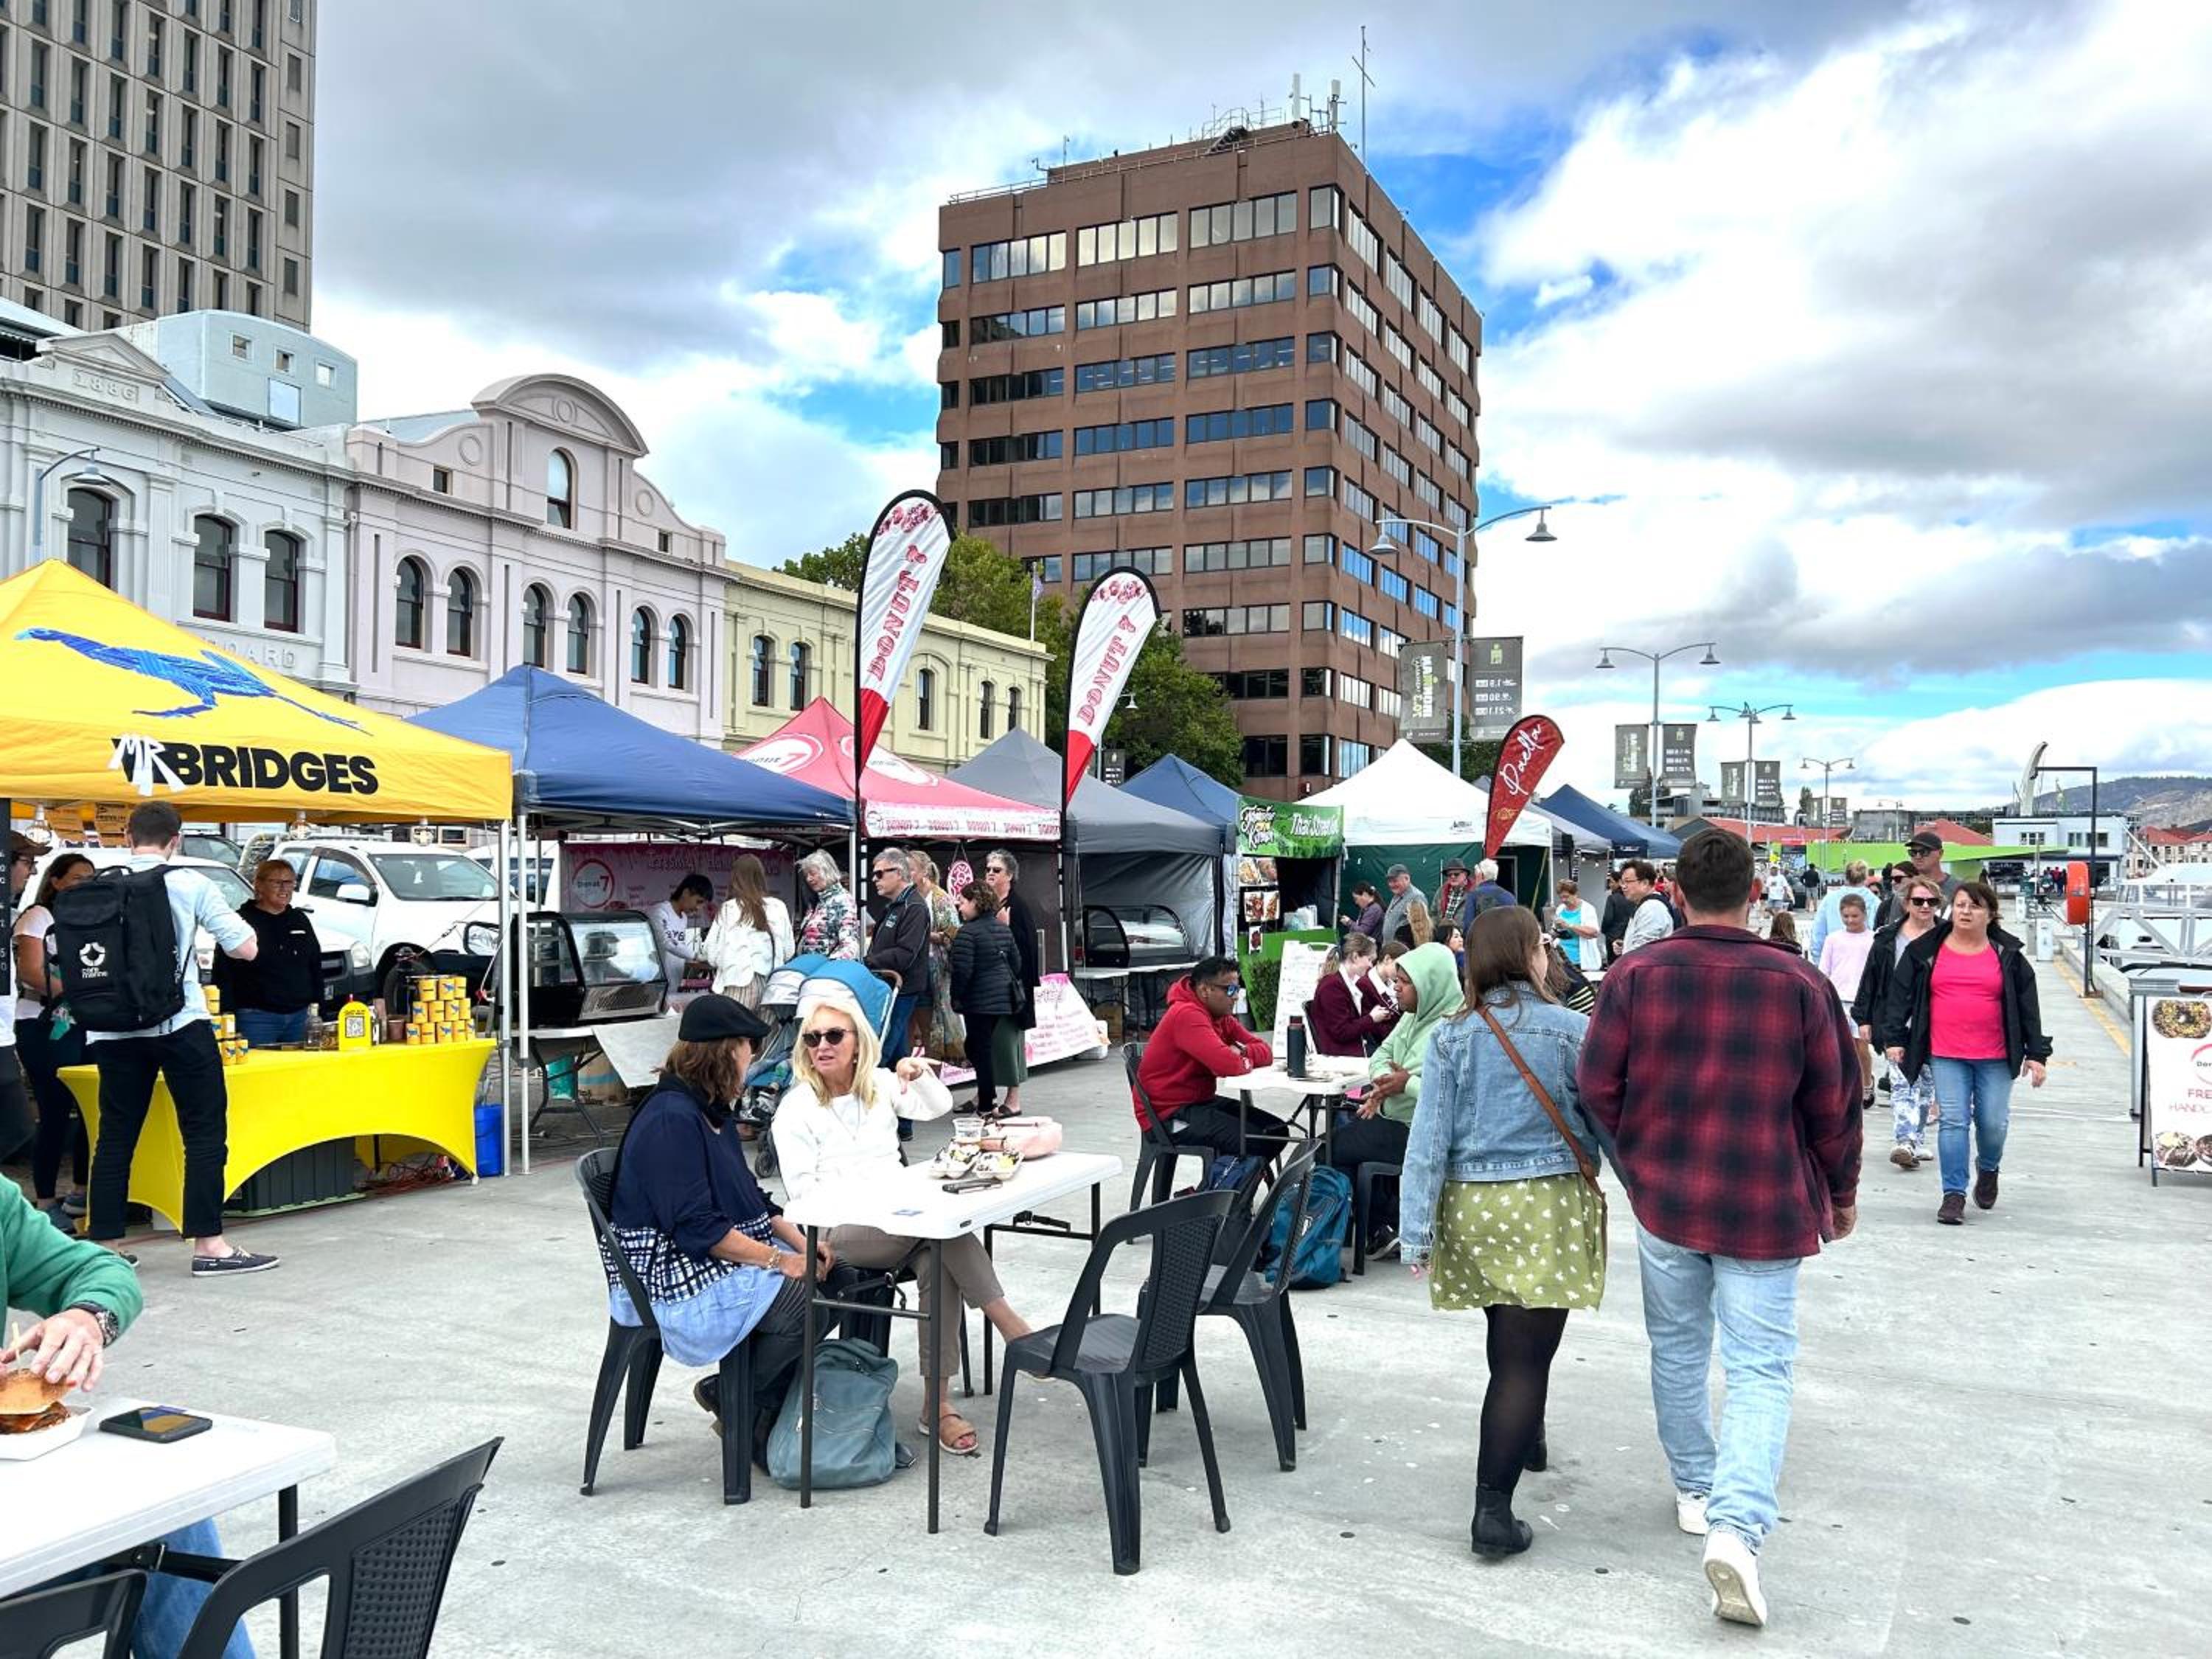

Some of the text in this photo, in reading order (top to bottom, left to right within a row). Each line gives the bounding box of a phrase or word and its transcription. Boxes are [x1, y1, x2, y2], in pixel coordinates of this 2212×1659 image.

[868, 571, 919, 681] DONUT
[1077, 635, 1128, 726] DONUT
[164, 740, 379, 795] BRIDGES
[1500, 725, 1543, 796] Paella
[600, 874, 609, 891] 7
